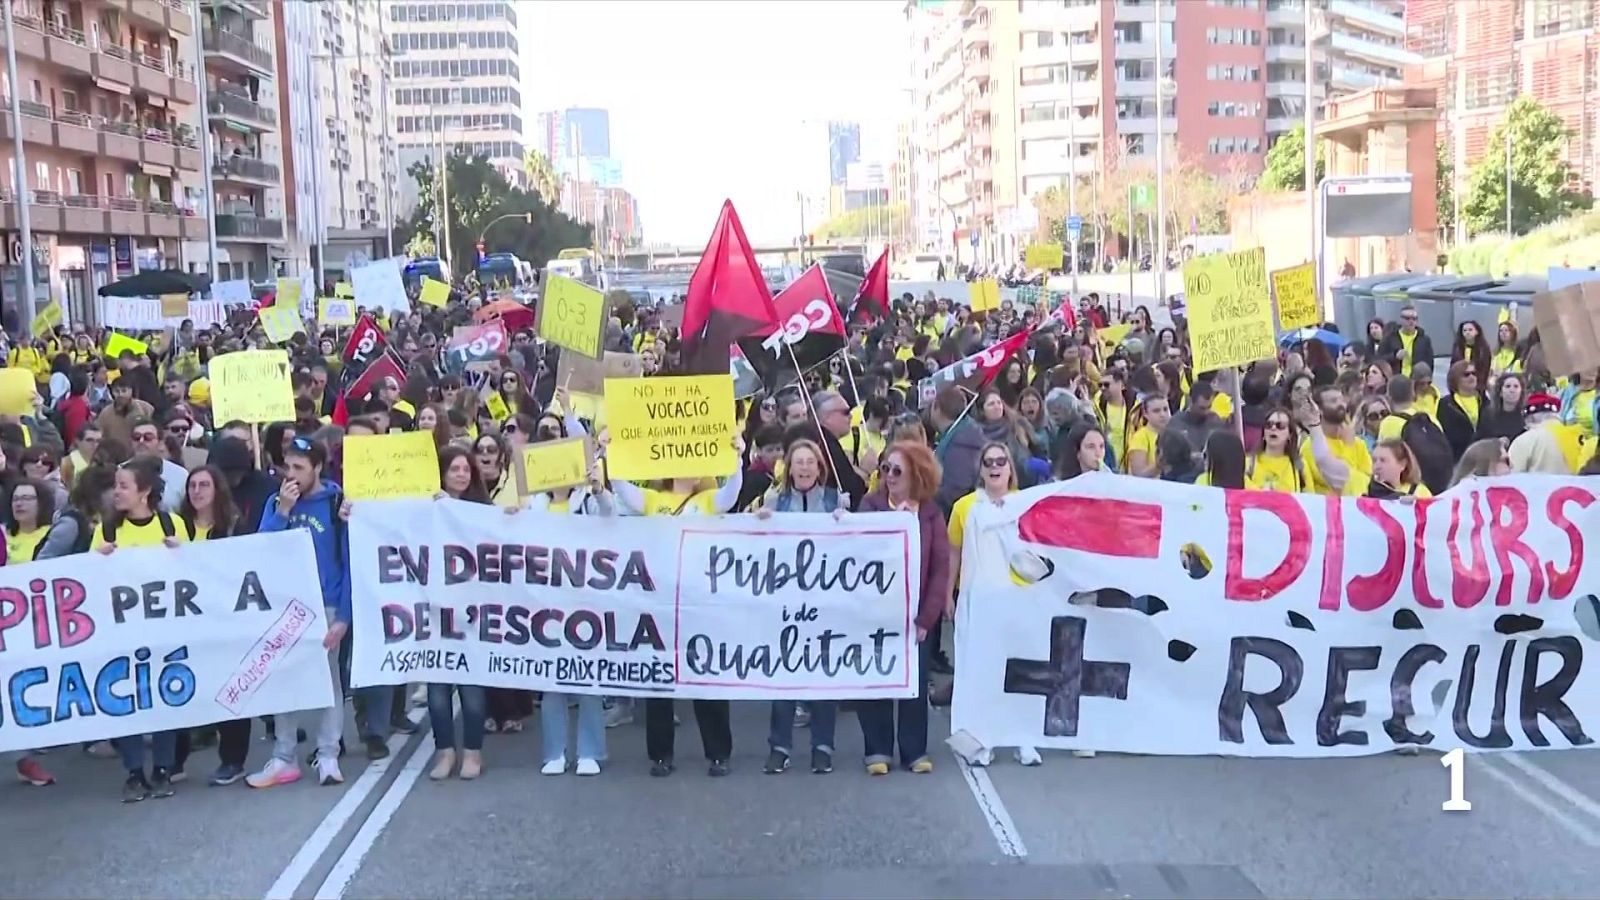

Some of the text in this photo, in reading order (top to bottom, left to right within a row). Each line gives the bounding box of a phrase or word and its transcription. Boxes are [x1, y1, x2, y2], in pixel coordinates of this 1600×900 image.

[557, 297, 587, 326] 0-3
[633, 385, 702, 398] NO HI HA
[646, 396, 710, 420] VOCACIÓ
[620, 427, 642, 440] QUE
[690, 422, 728, 436] AQUESTA
[649, 438, 719, 461] SITUACIÓ
[378, 543, 656, 592] EN DEFENSA
[704, 538, 896, 596] Pública
[1224, 485, 1598, 612] DISCURS
[110, 579, 204, 624] PER
[233, 570, 273, 612] A
[782, 602, 819, 623] i de
[440, 604, 666, 652] L'ESCOLA
[380, 650, 470, 674] ASSEMBLEA
[598, 655, 675, 684] PENEDÈS
[685, 624, 900, 681] Qualitat
[1218, 634, 1597, 749] RECUR
